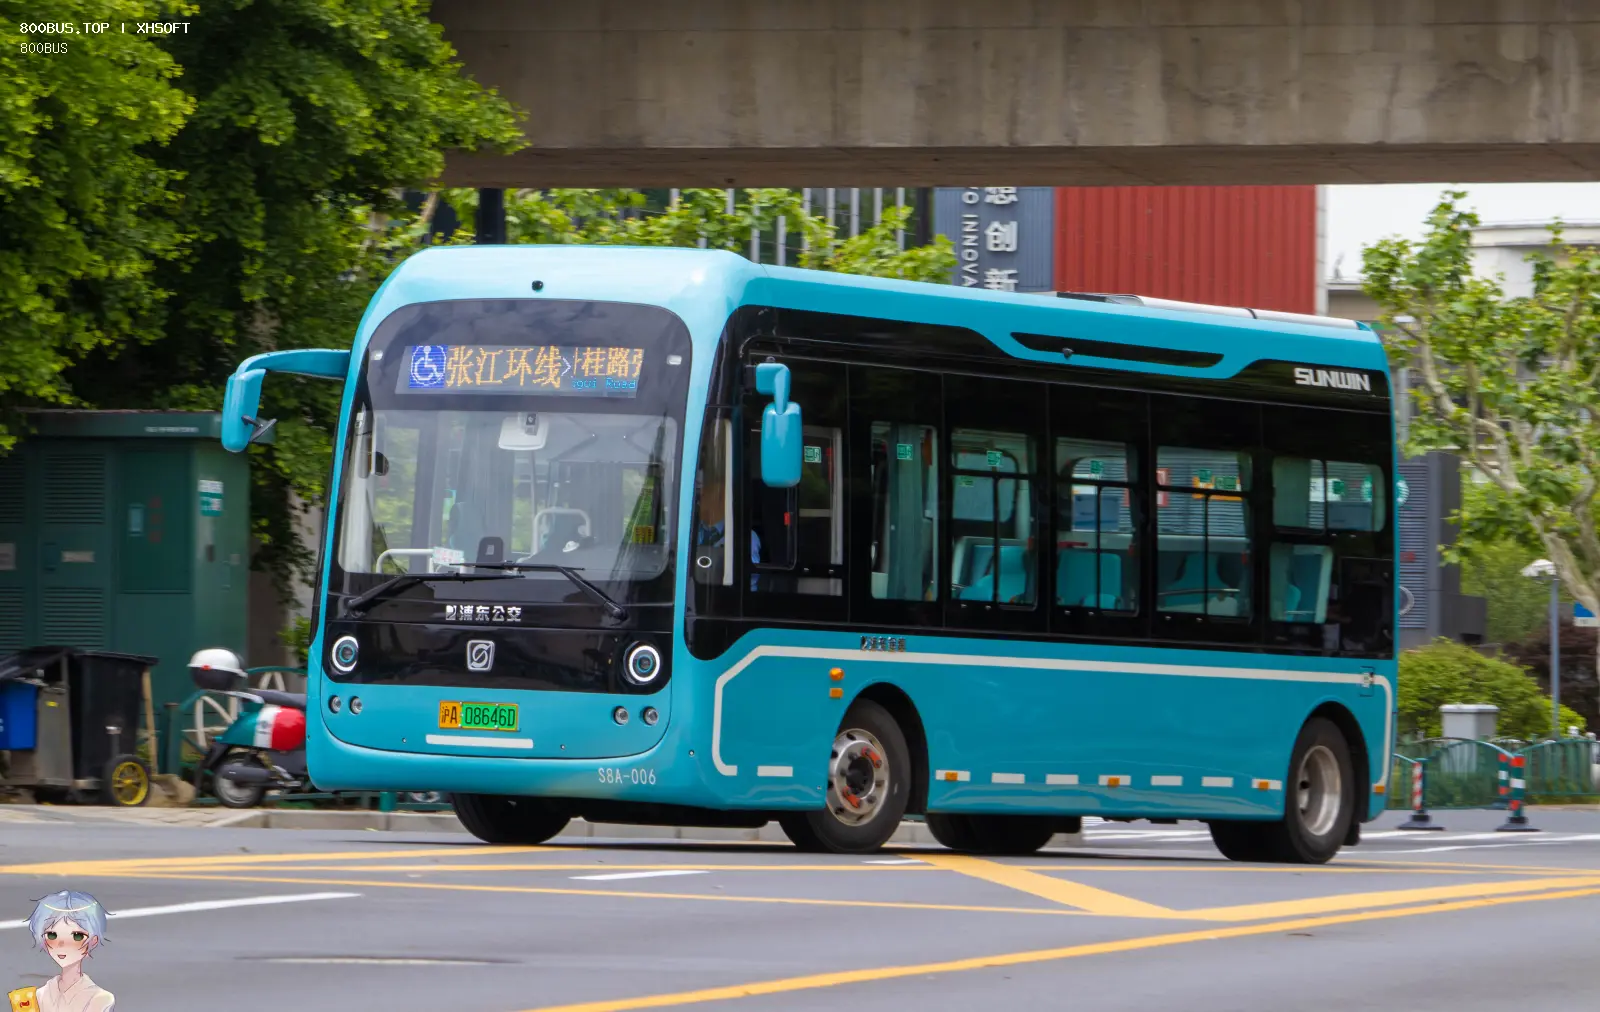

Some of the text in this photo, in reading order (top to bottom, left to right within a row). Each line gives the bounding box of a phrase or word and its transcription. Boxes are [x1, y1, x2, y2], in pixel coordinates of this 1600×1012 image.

[446, 345, 561, 389] 张江环线
[1294, 367, 1371, 392] SUNWIN
[459, 605, 522, 622] 浦东公交
[598, 767, 656, 785] S8A-006
